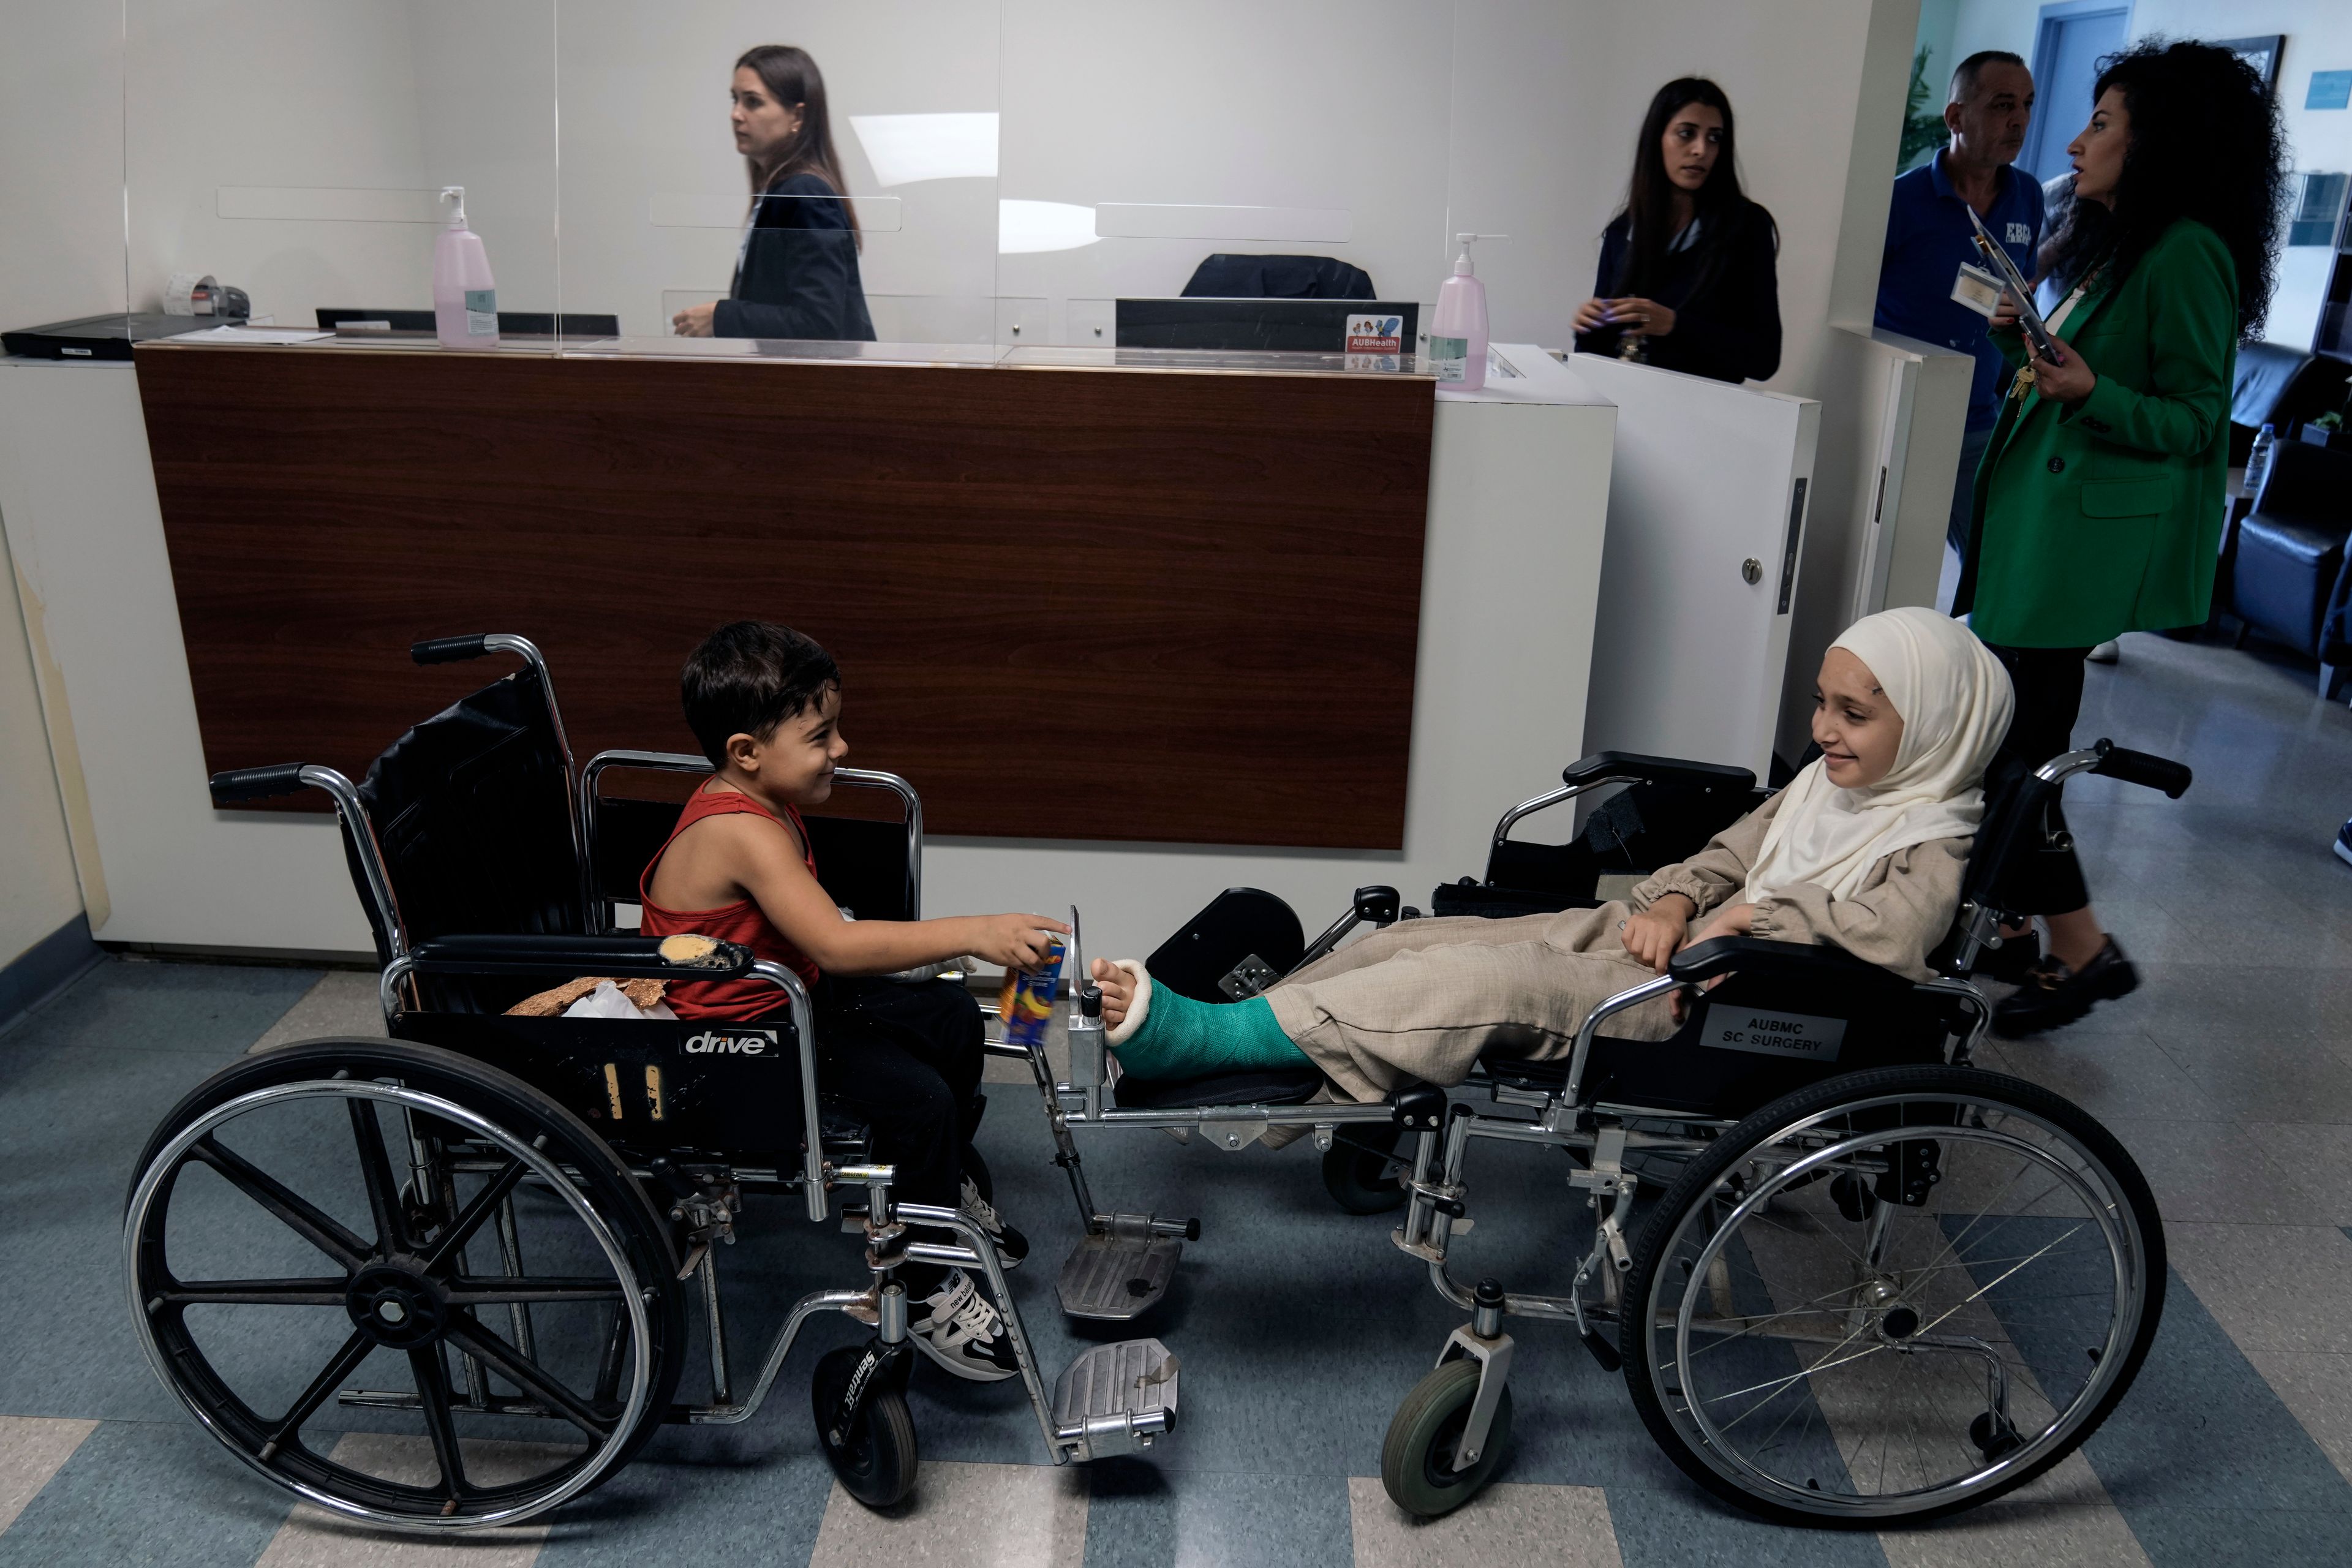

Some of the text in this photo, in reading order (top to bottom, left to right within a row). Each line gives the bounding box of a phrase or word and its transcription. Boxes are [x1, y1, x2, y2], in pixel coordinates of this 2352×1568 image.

[1747, 1018, 1804, 1035] AUBMC
[685, 1031, 765, 1055] drive
[1722, 1031, 1823, 1052] SC SURGERY
[951, 1295, 963, 1309] new
